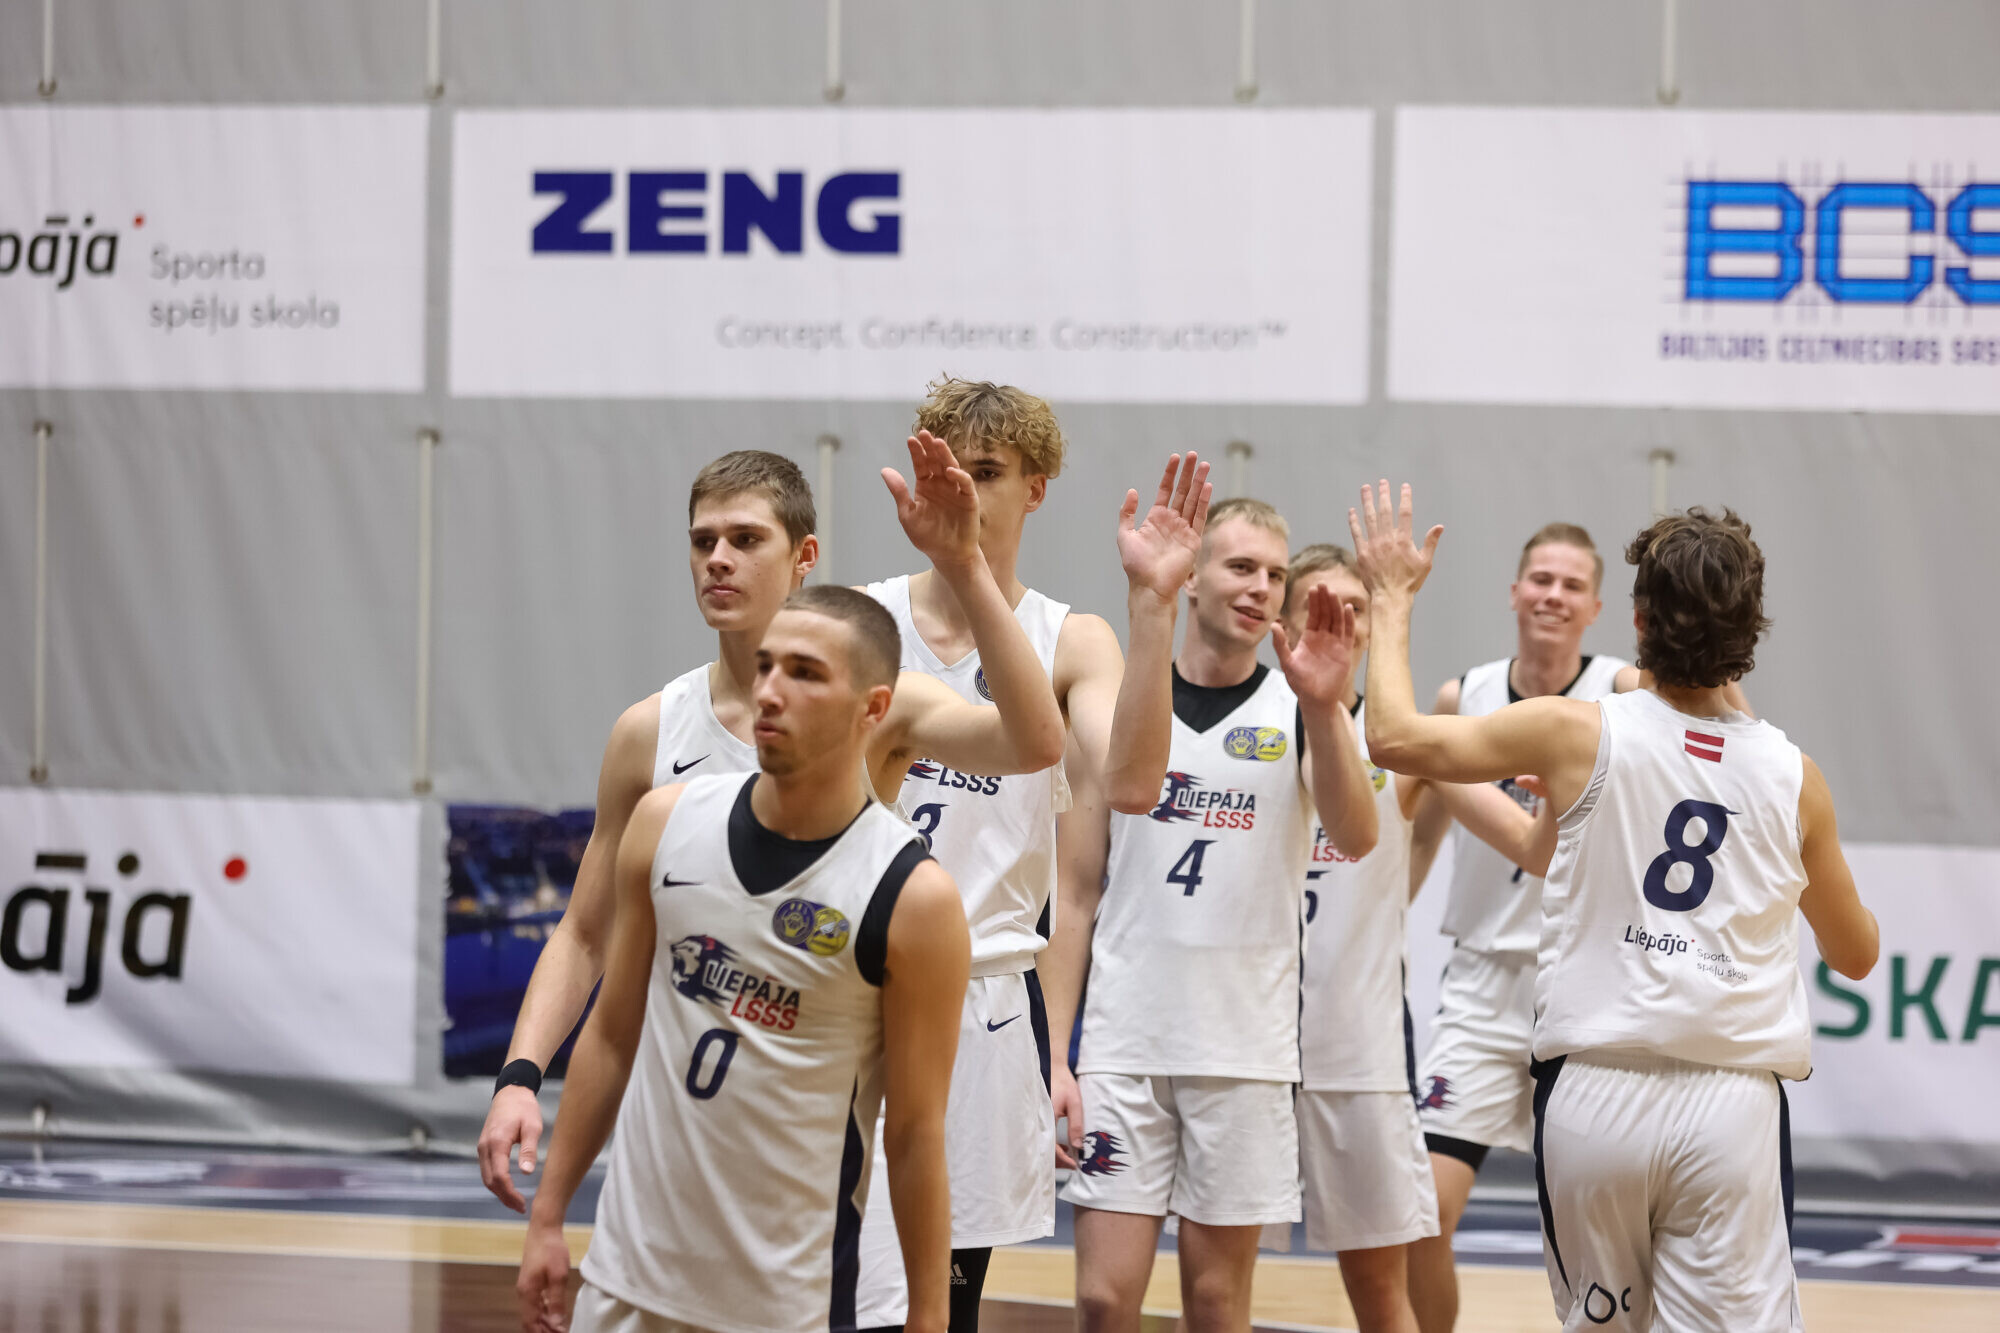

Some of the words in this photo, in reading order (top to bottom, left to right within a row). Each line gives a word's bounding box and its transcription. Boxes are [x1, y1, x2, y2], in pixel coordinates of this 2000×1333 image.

[531, 170, 902, 255] ZENG
[149, 245, 266, 284] Sporta
[248, 295, 341, 330] skola
[938, 766, 1002, 796] LSSS
[1177, 788, 1256, 811] LIEPĀJA
[1203, 810, 1256, 831] LSSS
[1166, 839, 1218, 897] 4
[1642, 799, 1740, 912] 8
[0, 853, 192, 1006] āja
[1624, 924, 1688, 956] Liepāja
[703, 960, 801, 1008] LIEPĀJA
[731, 993, 799, 1031] LSSS
[686, 1028, 741, 1100] 0
